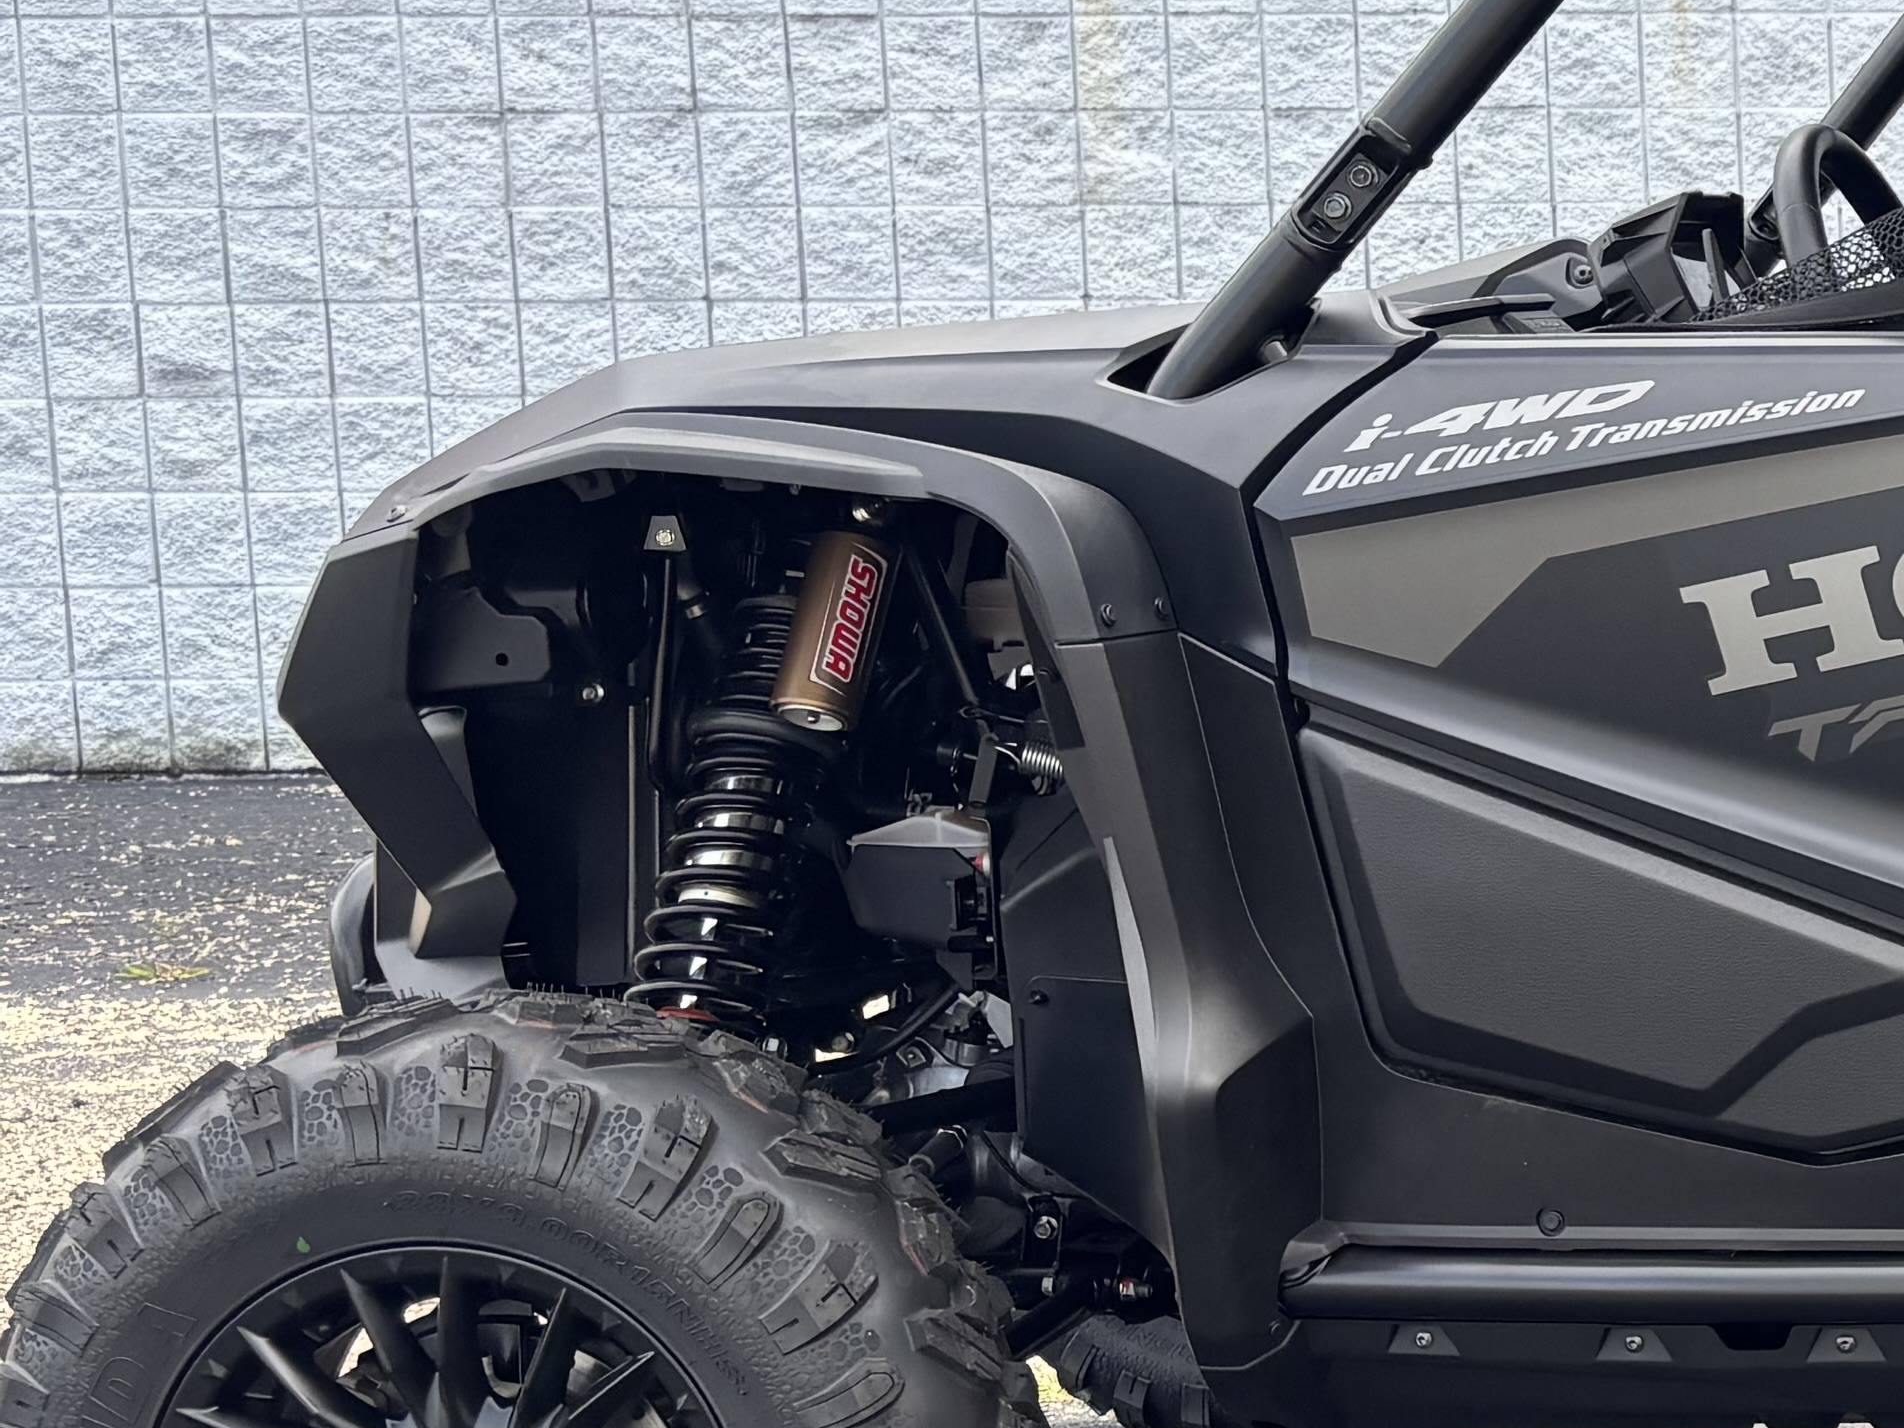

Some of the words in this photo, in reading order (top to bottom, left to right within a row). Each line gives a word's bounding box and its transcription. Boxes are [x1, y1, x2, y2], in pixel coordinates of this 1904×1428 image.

[1302, 453, 1410, 496] Dual
[1415, 431, 1560, 476] Clutch
[1565, 388, 1867, 451] Transmission
[1343, 379, 1656, 452] i-4WD
[822, 554, 878, 683] SHOWA
